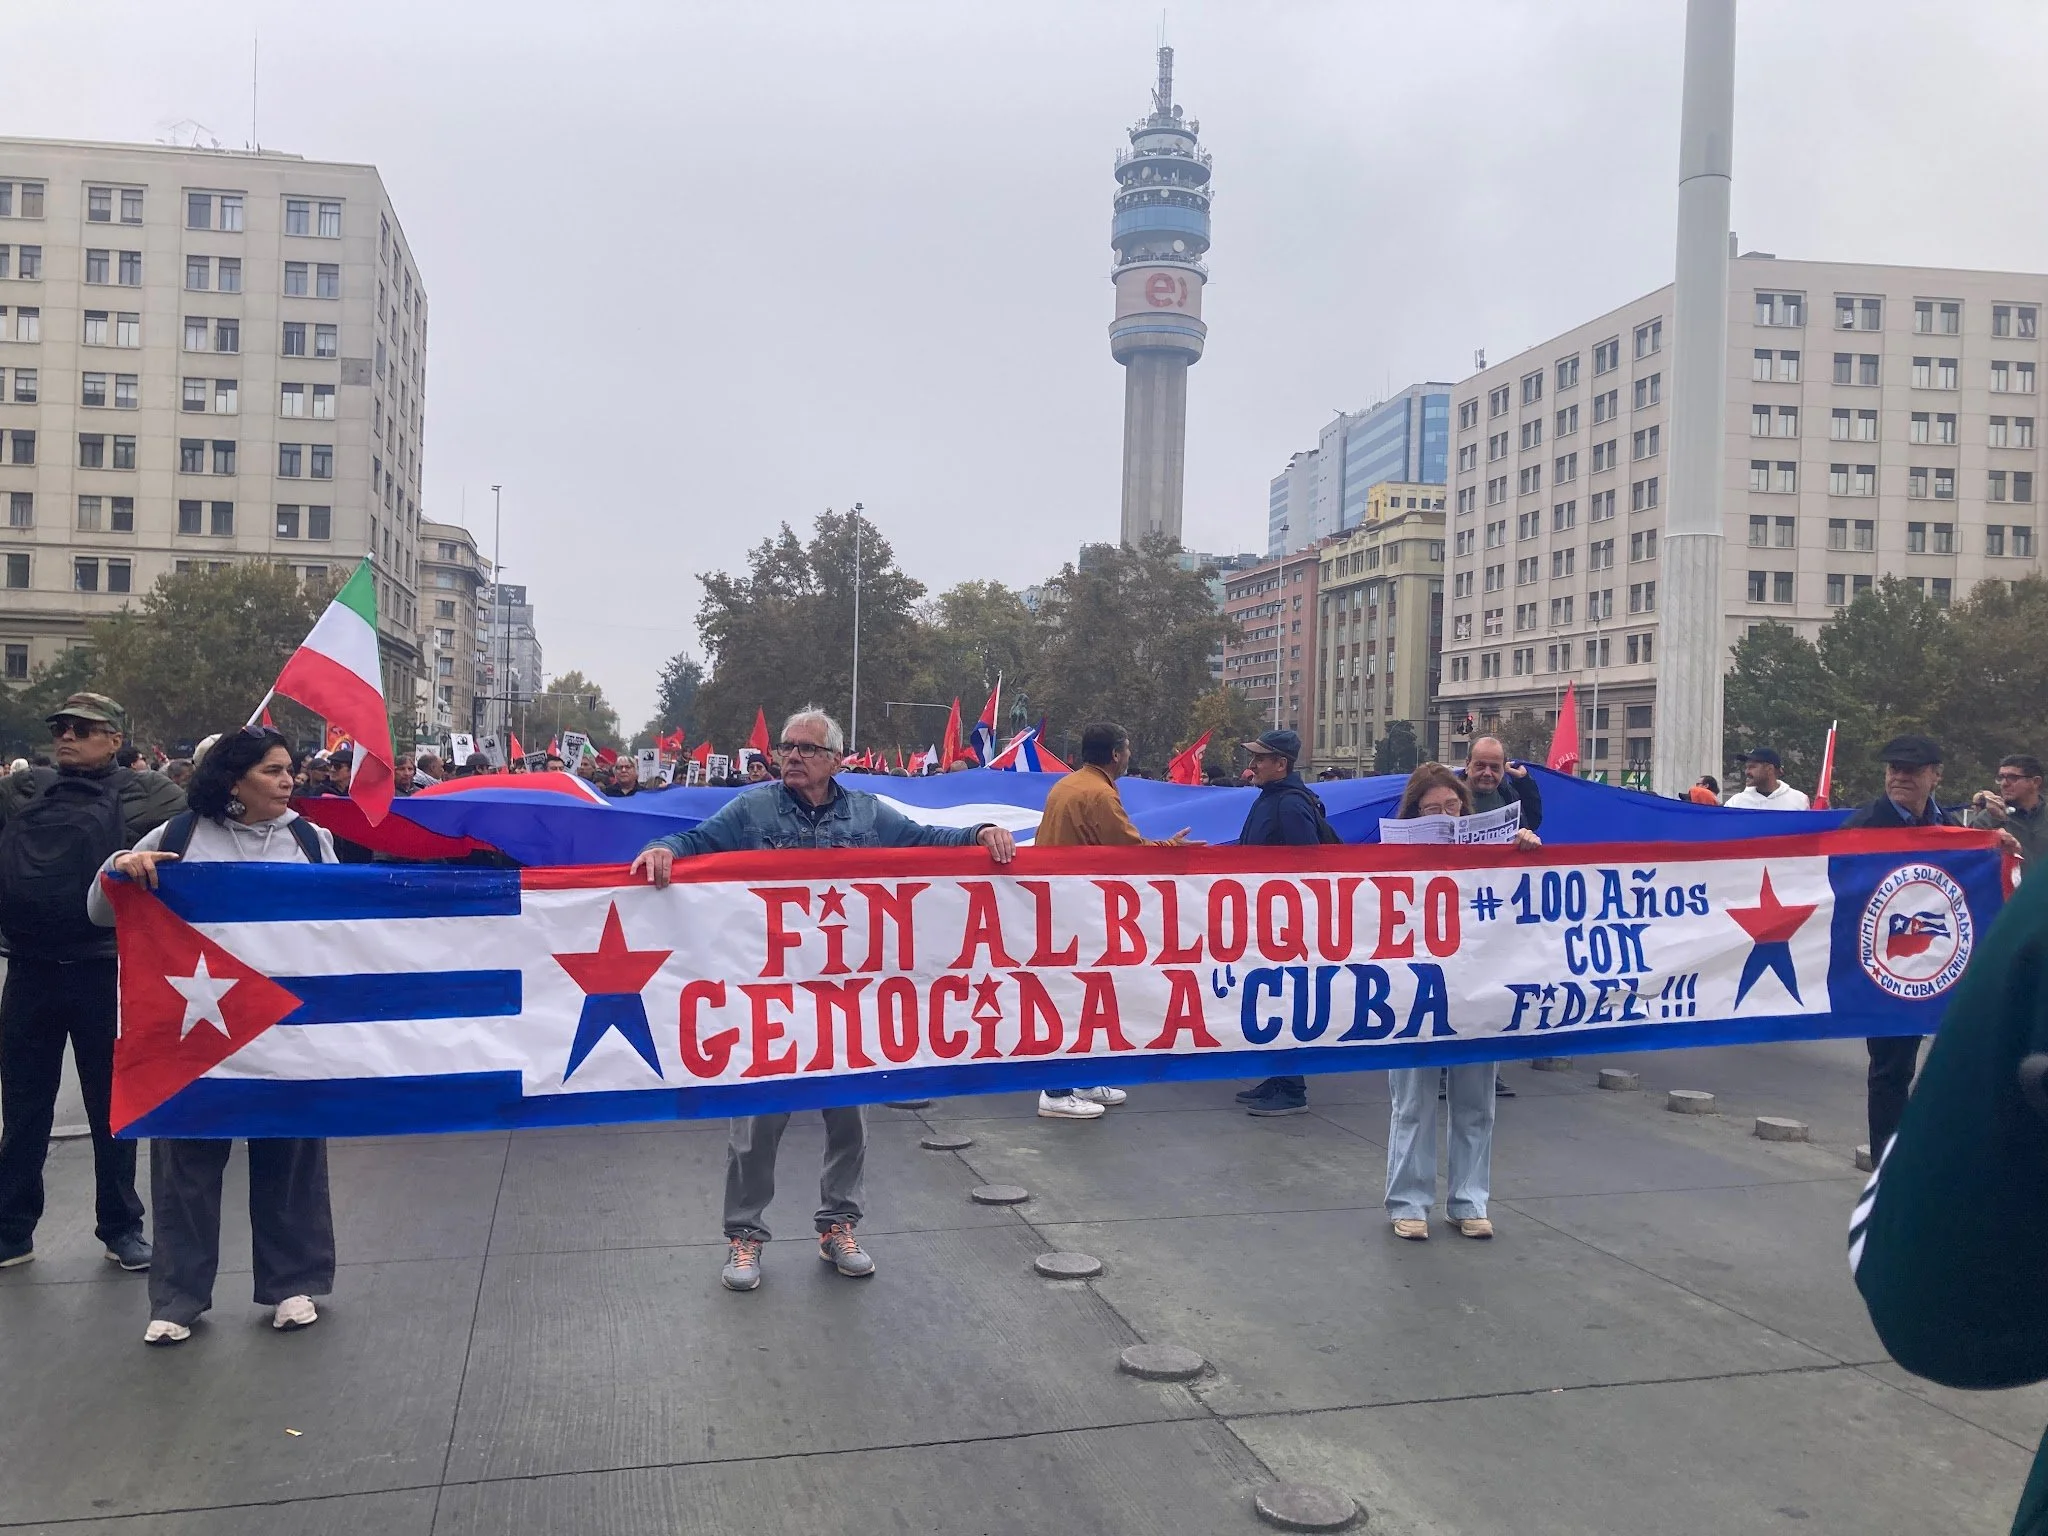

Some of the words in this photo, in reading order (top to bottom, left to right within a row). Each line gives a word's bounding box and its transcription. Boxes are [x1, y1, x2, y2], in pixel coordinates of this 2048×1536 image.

[1472, 823, 1514, 843] Primera
[1594, 867, 1709, 921] Años
[1895, 869, 1908, 886] DE
[947, 880, 1080, 970] AL
[1091, 876, 1462, 967] BLOQUEO
[1565, 922, 1653, 976] CON
[1144, 969, 1222, 1050] A
[1880, 974, 1902, 994] CON
[1904, 982, 1936, 997] CUBA
[1936, 972, 1950, 989] EN
